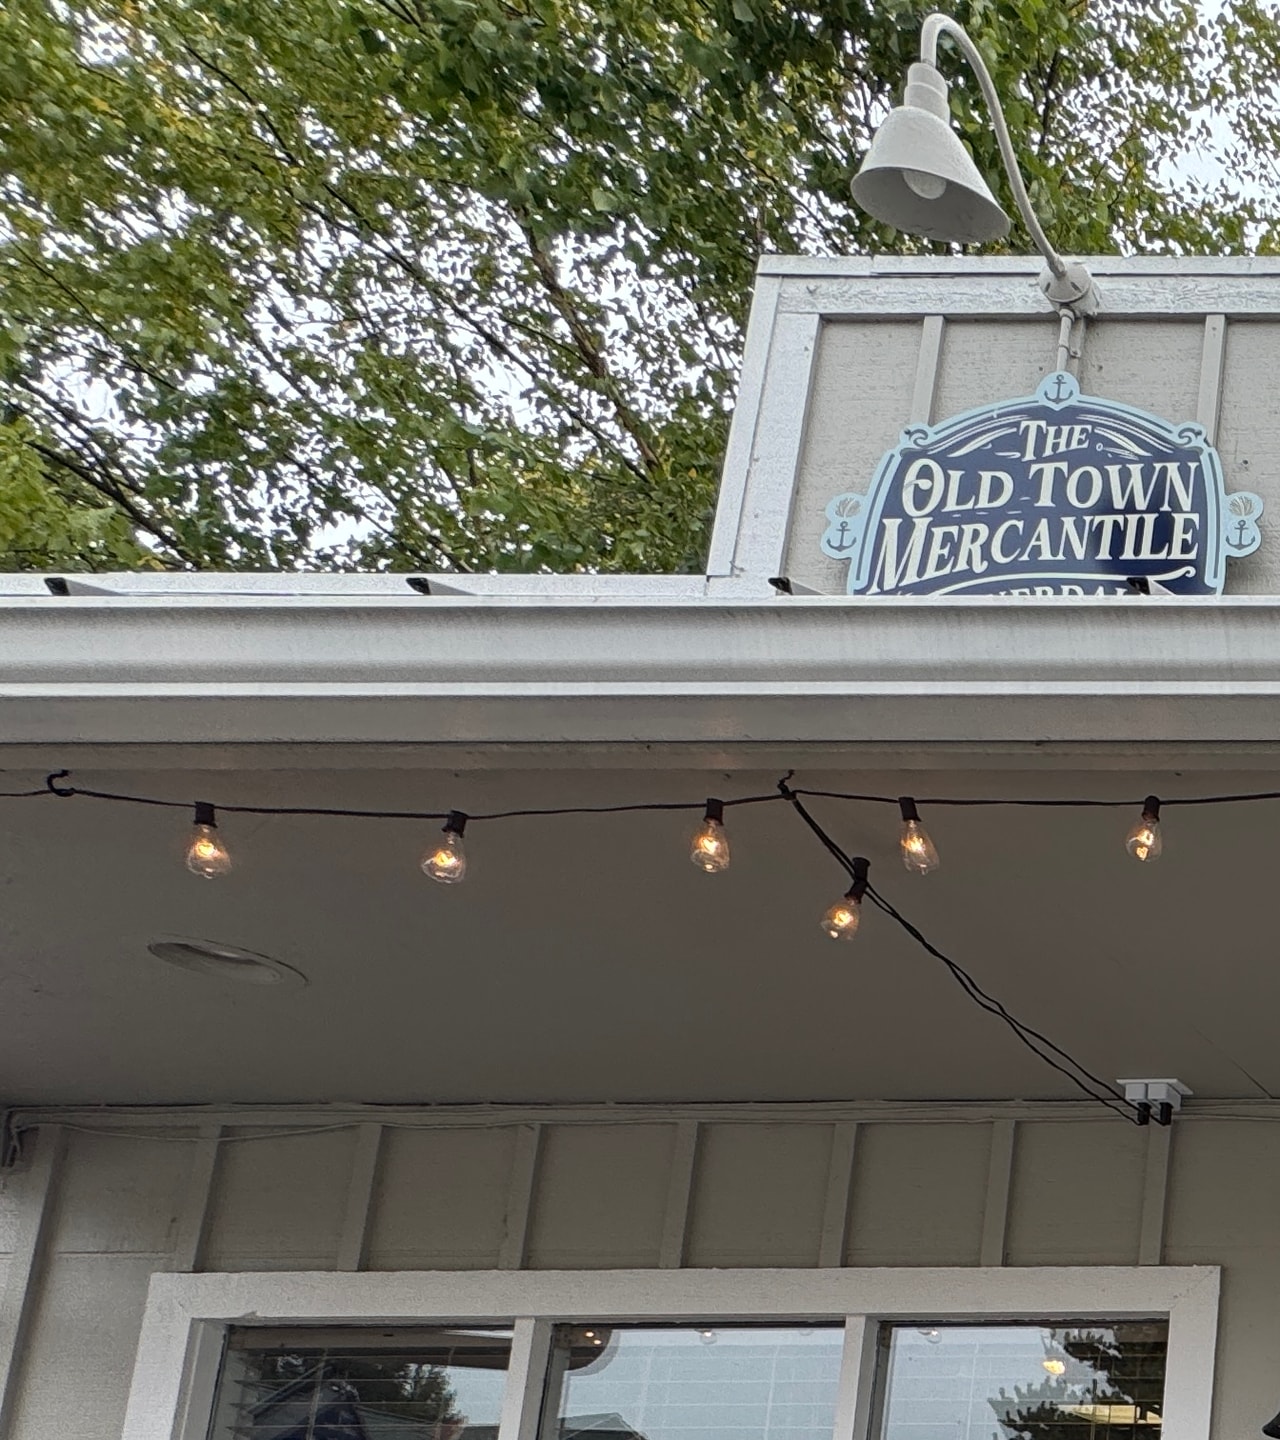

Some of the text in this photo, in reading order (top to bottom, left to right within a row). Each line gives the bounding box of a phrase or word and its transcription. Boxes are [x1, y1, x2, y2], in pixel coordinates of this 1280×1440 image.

[1019, 420, 1093, 462] THE
[902, 458, 1201, 517] OLD TOWN
[867, 512, 1200, 595] MERCANTILE
